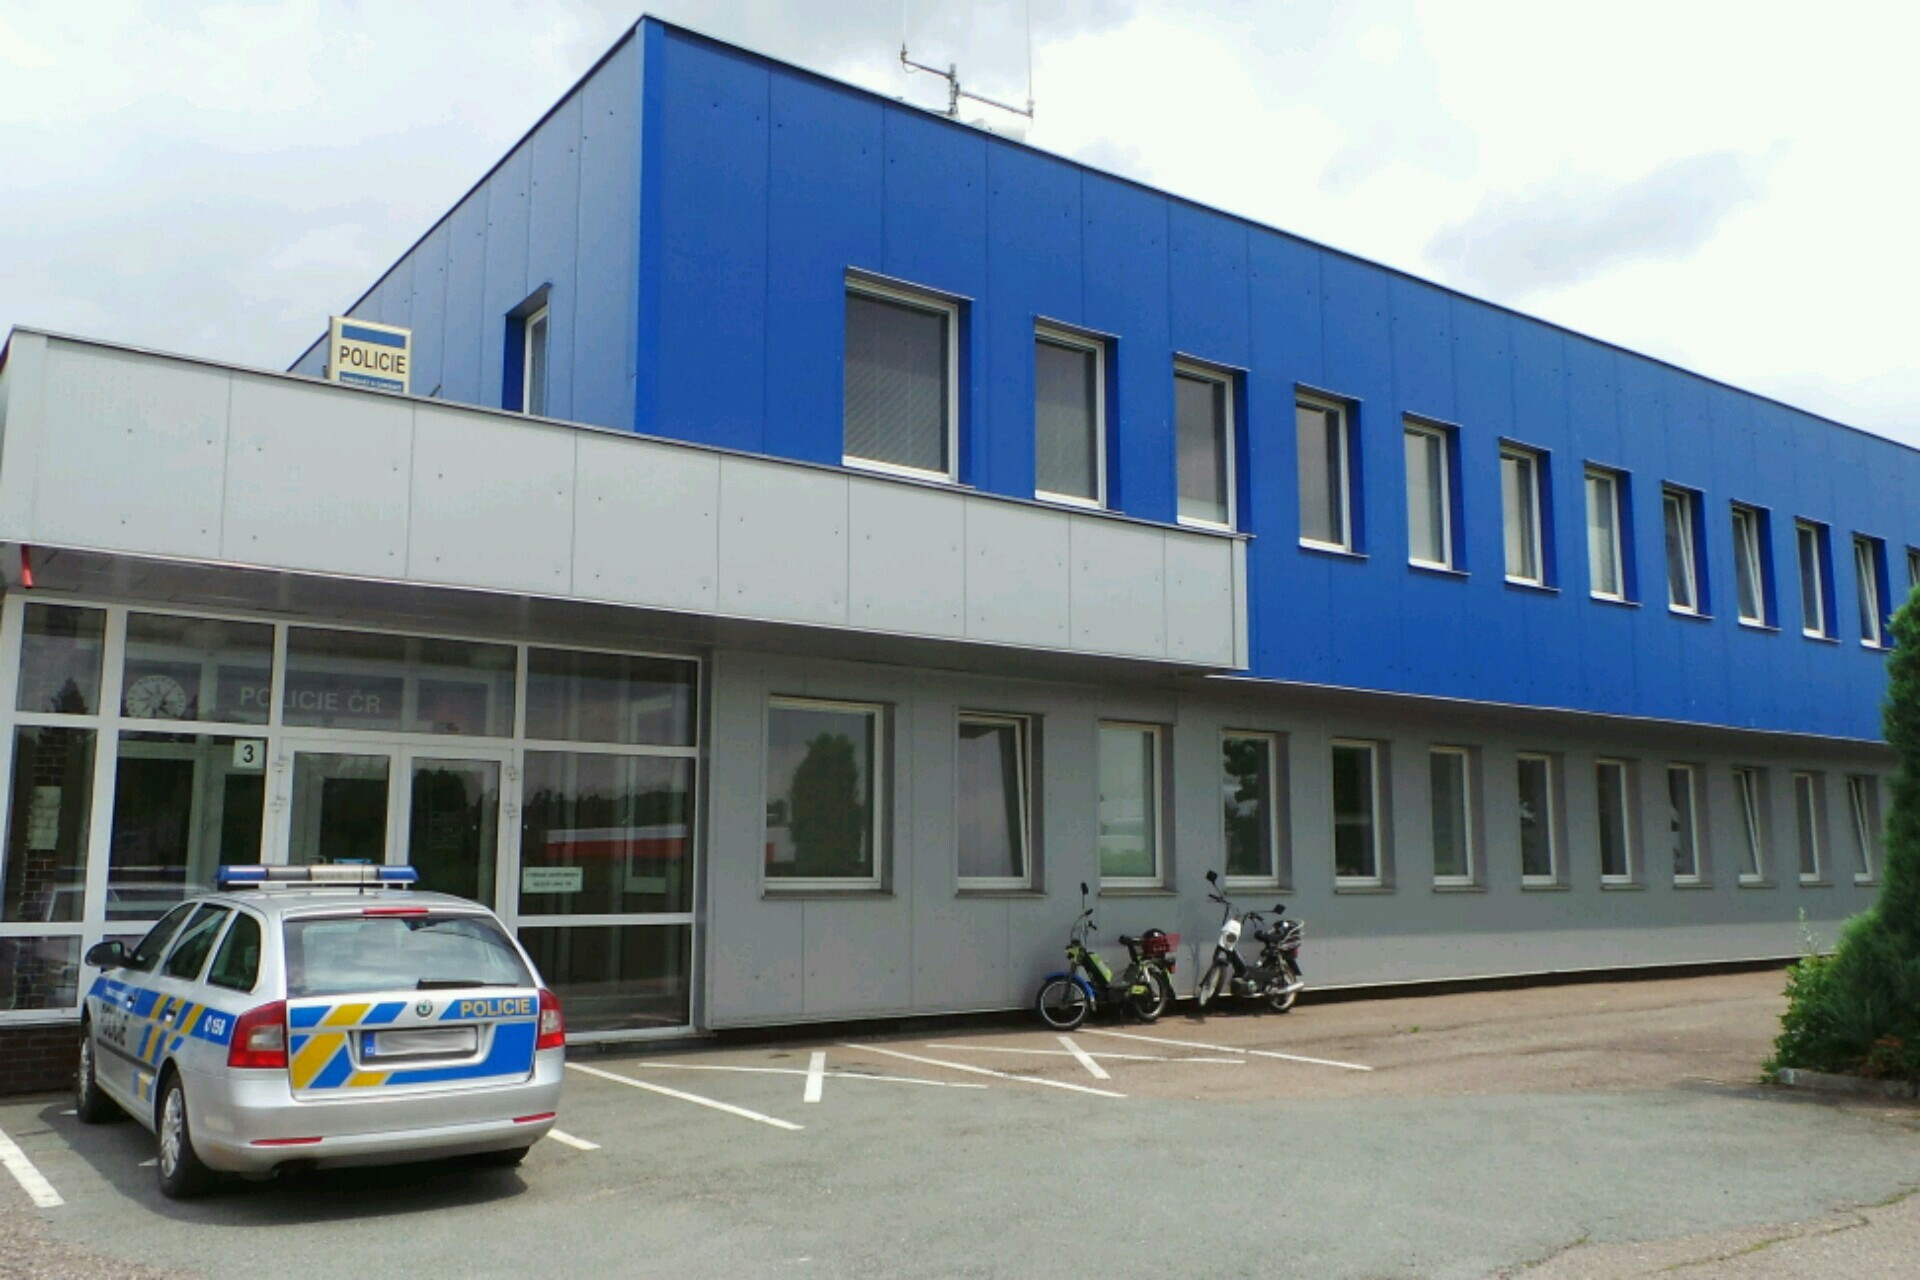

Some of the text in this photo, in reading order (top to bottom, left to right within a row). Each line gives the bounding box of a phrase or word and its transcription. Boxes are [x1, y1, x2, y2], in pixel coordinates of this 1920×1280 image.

[339, 345, 406, 374] POLICIE
[240, 687, 381, 713] POICIE ČR
[242, 744, 254, 763] 3
[461, 998, 531, 1018] POLICIE
